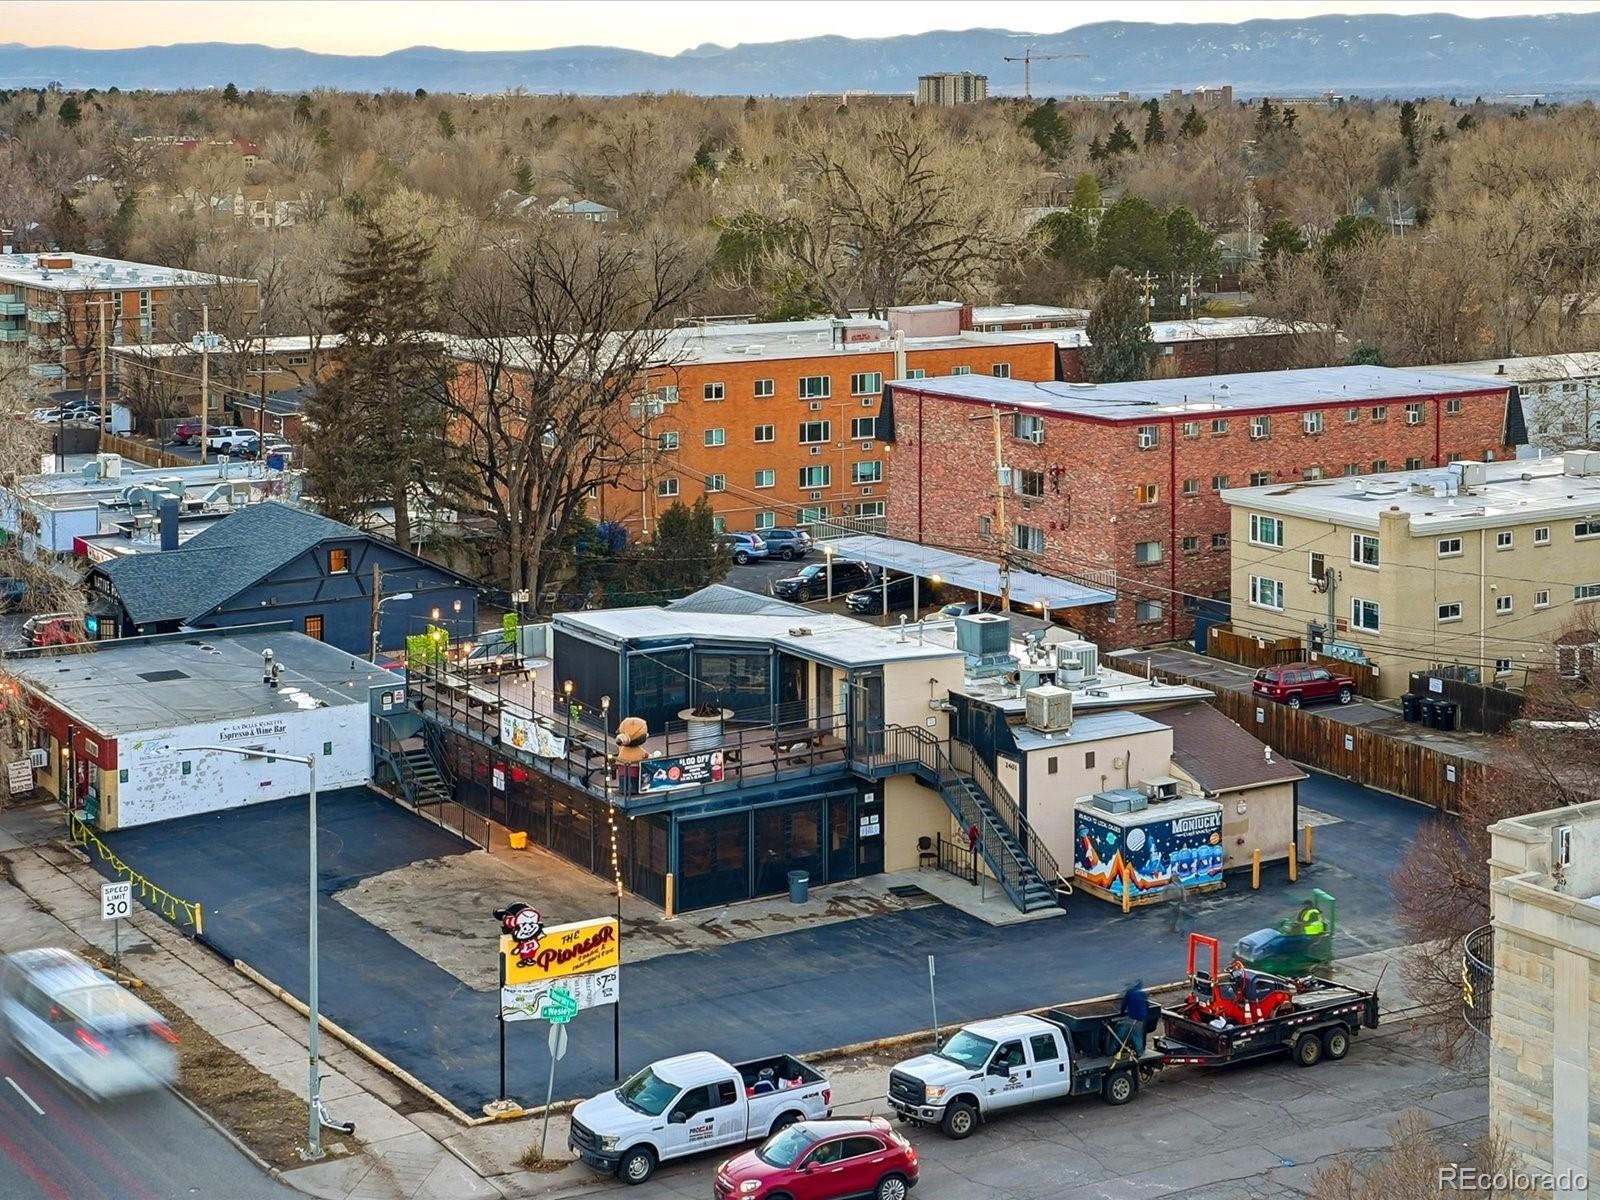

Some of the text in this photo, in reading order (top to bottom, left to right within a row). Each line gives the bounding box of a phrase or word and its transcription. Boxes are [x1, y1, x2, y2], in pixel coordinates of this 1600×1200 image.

[220, 729, 249, 741] Espresso
[256, 726, 273, 735] Wine
[274, 724, 286, 733] Bar
[696, 754, 709, 764] OFF
[105, 885, 129, 895] SPEED
[107, 893, 126, 902] LIMIT
[106, 901, 128, 916] 30
[562, 930, 580, 944] THE
